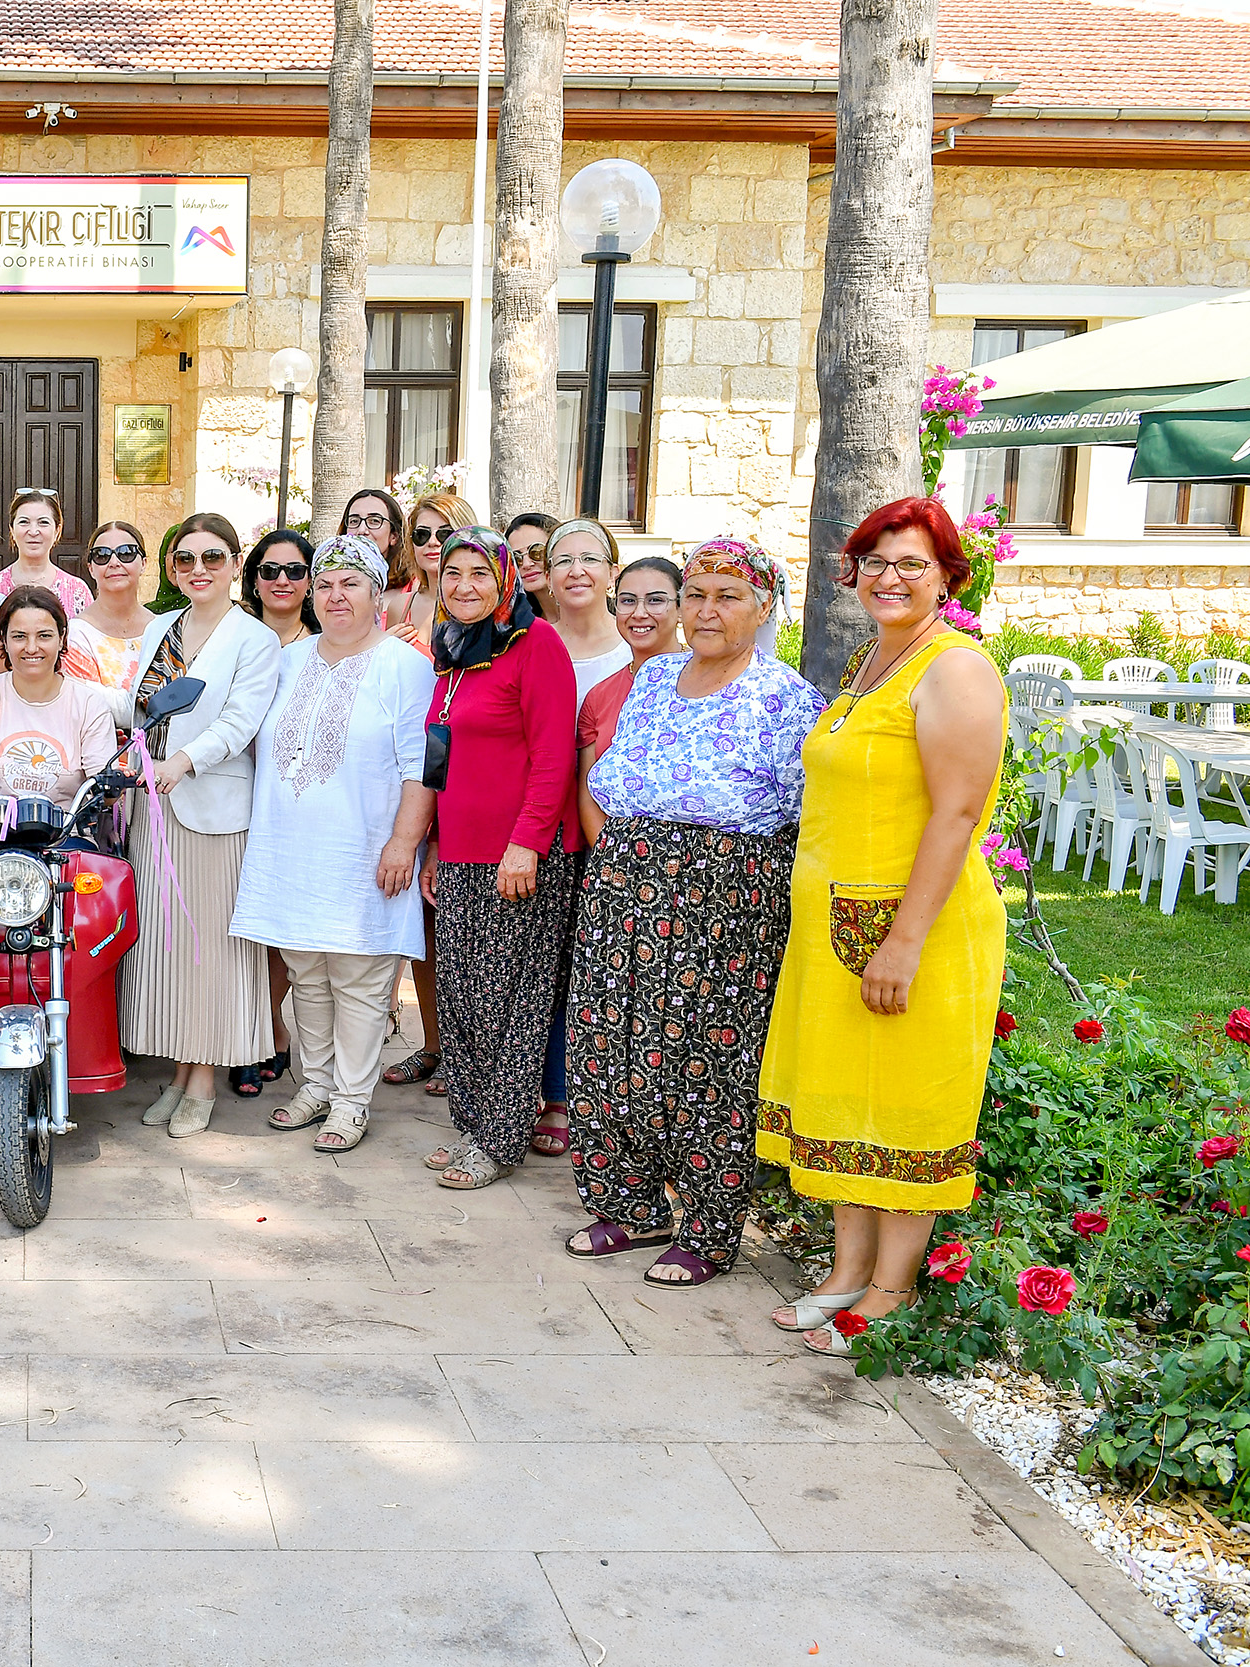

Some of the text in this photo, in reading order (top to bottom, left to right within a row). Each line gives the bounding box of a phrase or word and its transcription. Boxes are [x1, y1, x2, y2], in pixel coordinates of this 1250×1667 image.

[72, 203, 153, 247] ÇİFTLİĞİ
[102, 254, 155, 268] BİNASI
[966, 408, 1141, 435] MERSİN BÜYÜKŞEHİR BELEDİYE
[12, 777, 49, 792] GREAT!
